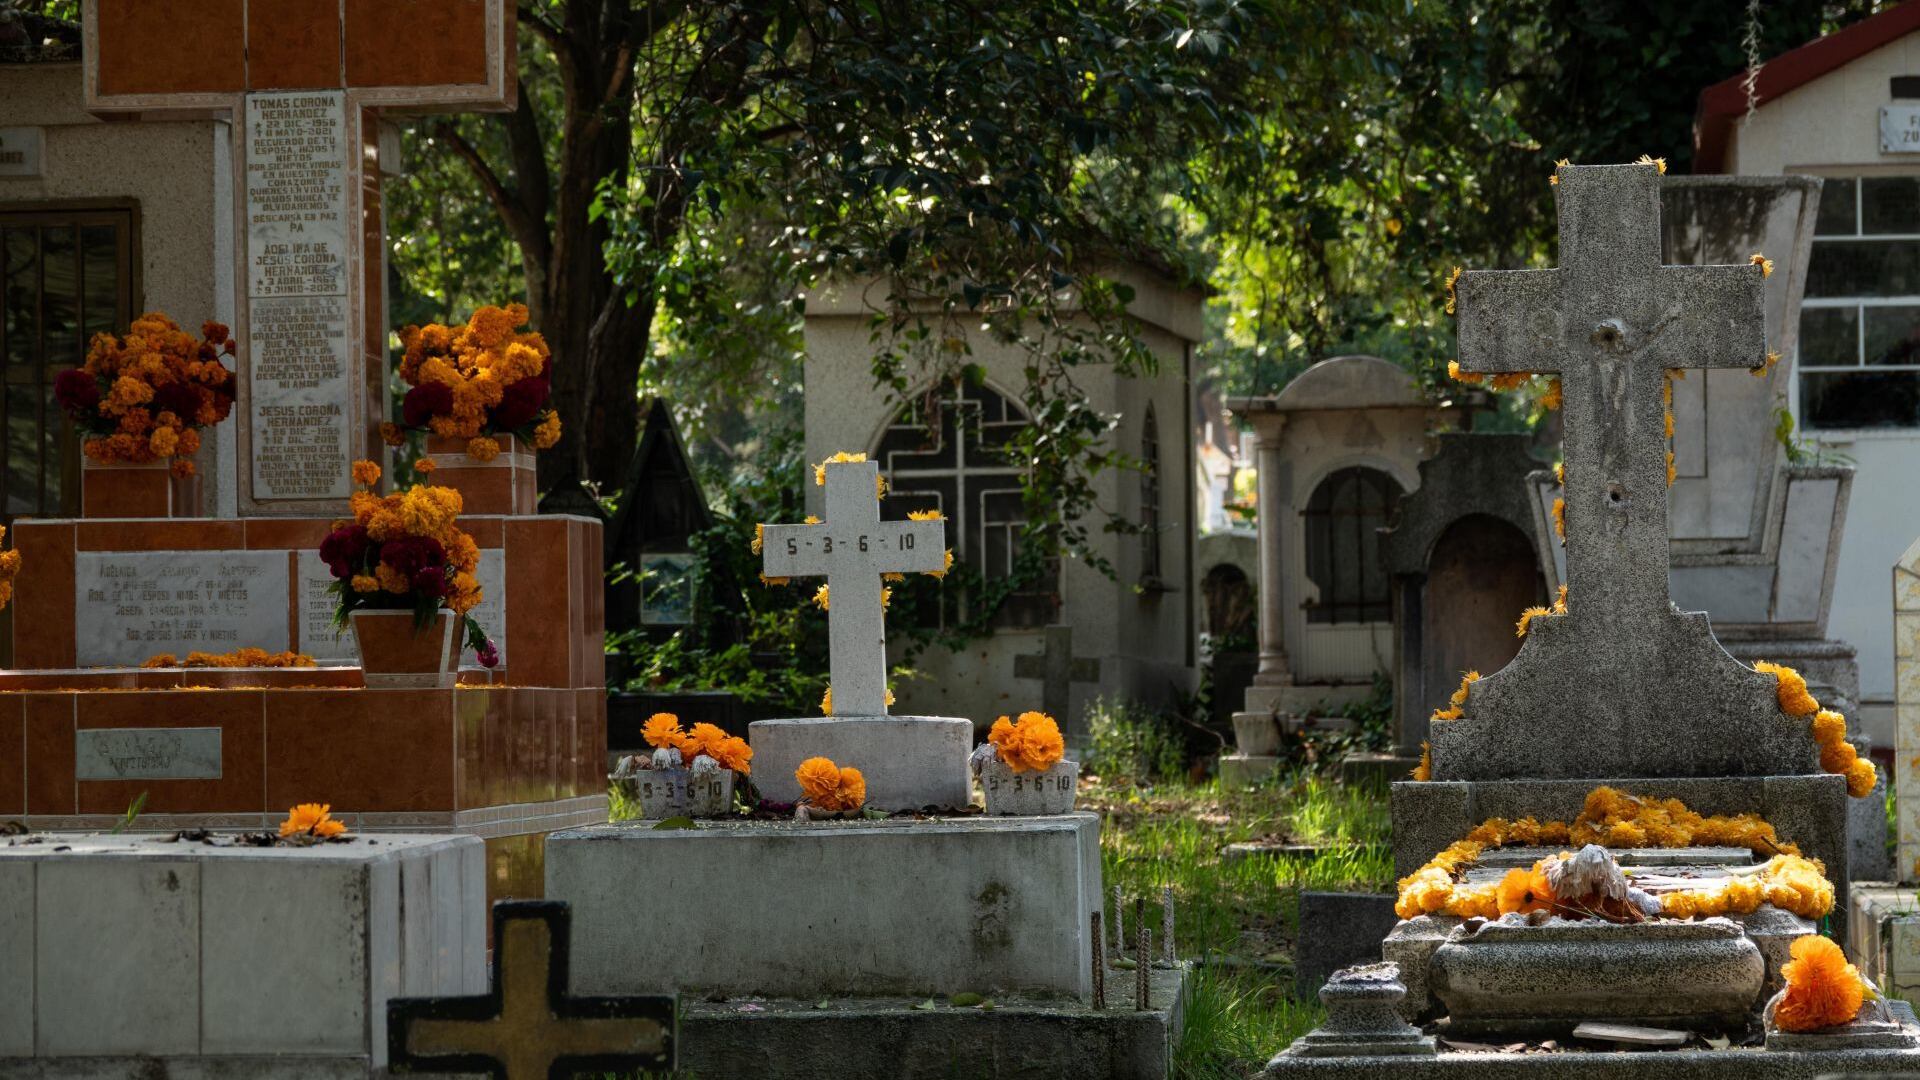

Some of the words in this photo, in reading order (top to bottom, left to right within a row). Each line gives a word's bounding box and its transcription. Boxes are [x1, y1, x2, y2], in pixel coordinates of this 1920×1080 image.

[252, 98, 290, 110] TOMAS
[293, 96, 336, 108] CORONA
[262, 108, 327, 120] HERNANDEZ
[254, 138, 304, 146] RECUERDO
[276, 154, 312, 162] NIETOS
[248, 163, 265, 172] POR
[268, 162, 309, 170] SIEMPRE
[263, 171, 275, 179] EN
[279, 170, 330, 178] NUESTROS
[268, 178, 325, 187] CORAZONES
[294, 194, 324, 202] NUNCA
[263, 202, 329, 211] OLVIDAREMOS
[313, 242, 328, 253] DE
[256, 255, 291, 265] JESUS
[294, 253, 336, 264] CORONA
[264, 265, 328, 277] HERNANDEZ
[259, 406, 294, 416] JESUS
[299, 404, 341, 416] CORONA
[267, 417, 331, 428] HERNANDEZ
[262, 446, 317, 454] RECUERDO
[283, 478, 336, 486] NUESTROS
